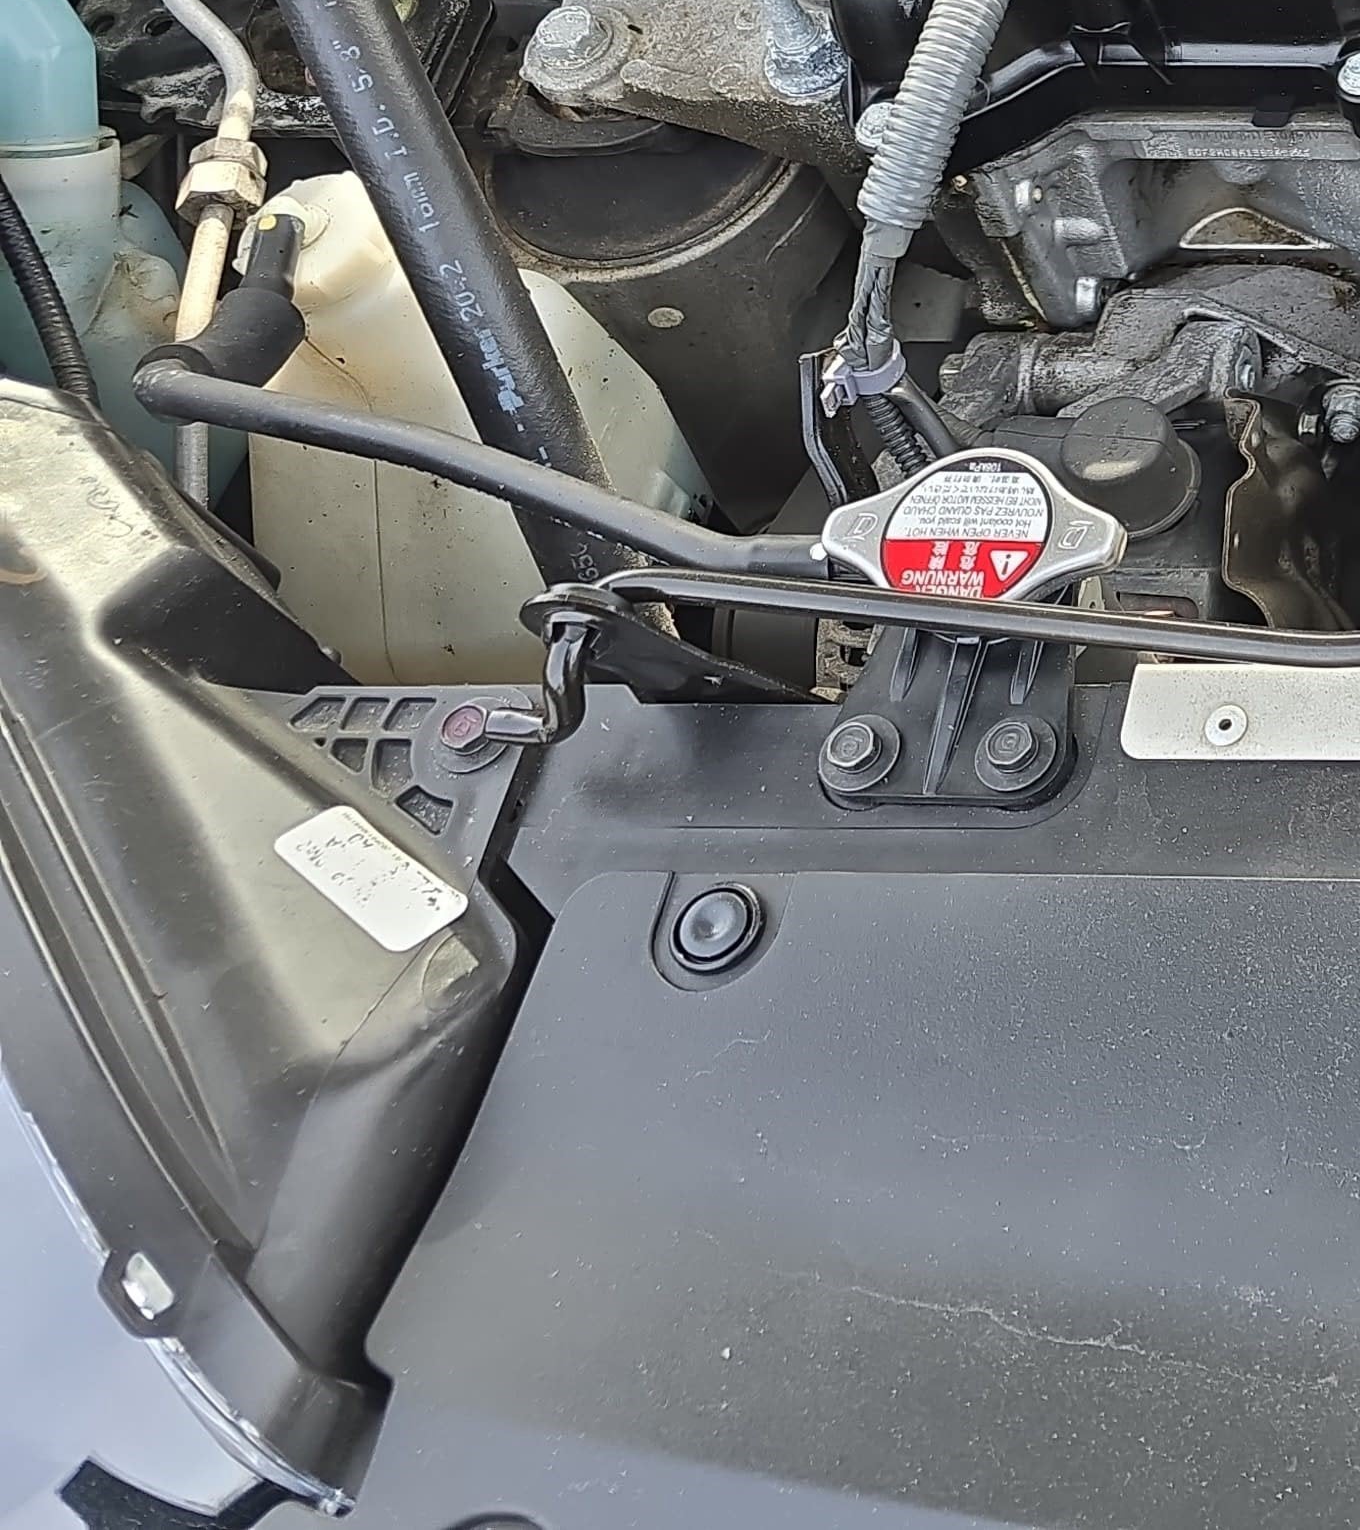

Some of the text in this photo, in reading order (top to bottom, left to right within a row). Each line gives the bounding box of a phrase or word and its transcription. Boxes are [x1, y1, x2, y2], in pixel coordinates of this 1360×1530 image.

[938, 506, 973, 516] QUAND
[974, 506, 994, 516] PAS
[1015, 519, 1031, 528] Hot
[929, 527, 960, 537] WHEN
[962, 528, 991, 538] OPEN
[994, 529, 1030, 538] NEVER
[901, 570, 985, 586] WARNUNG
